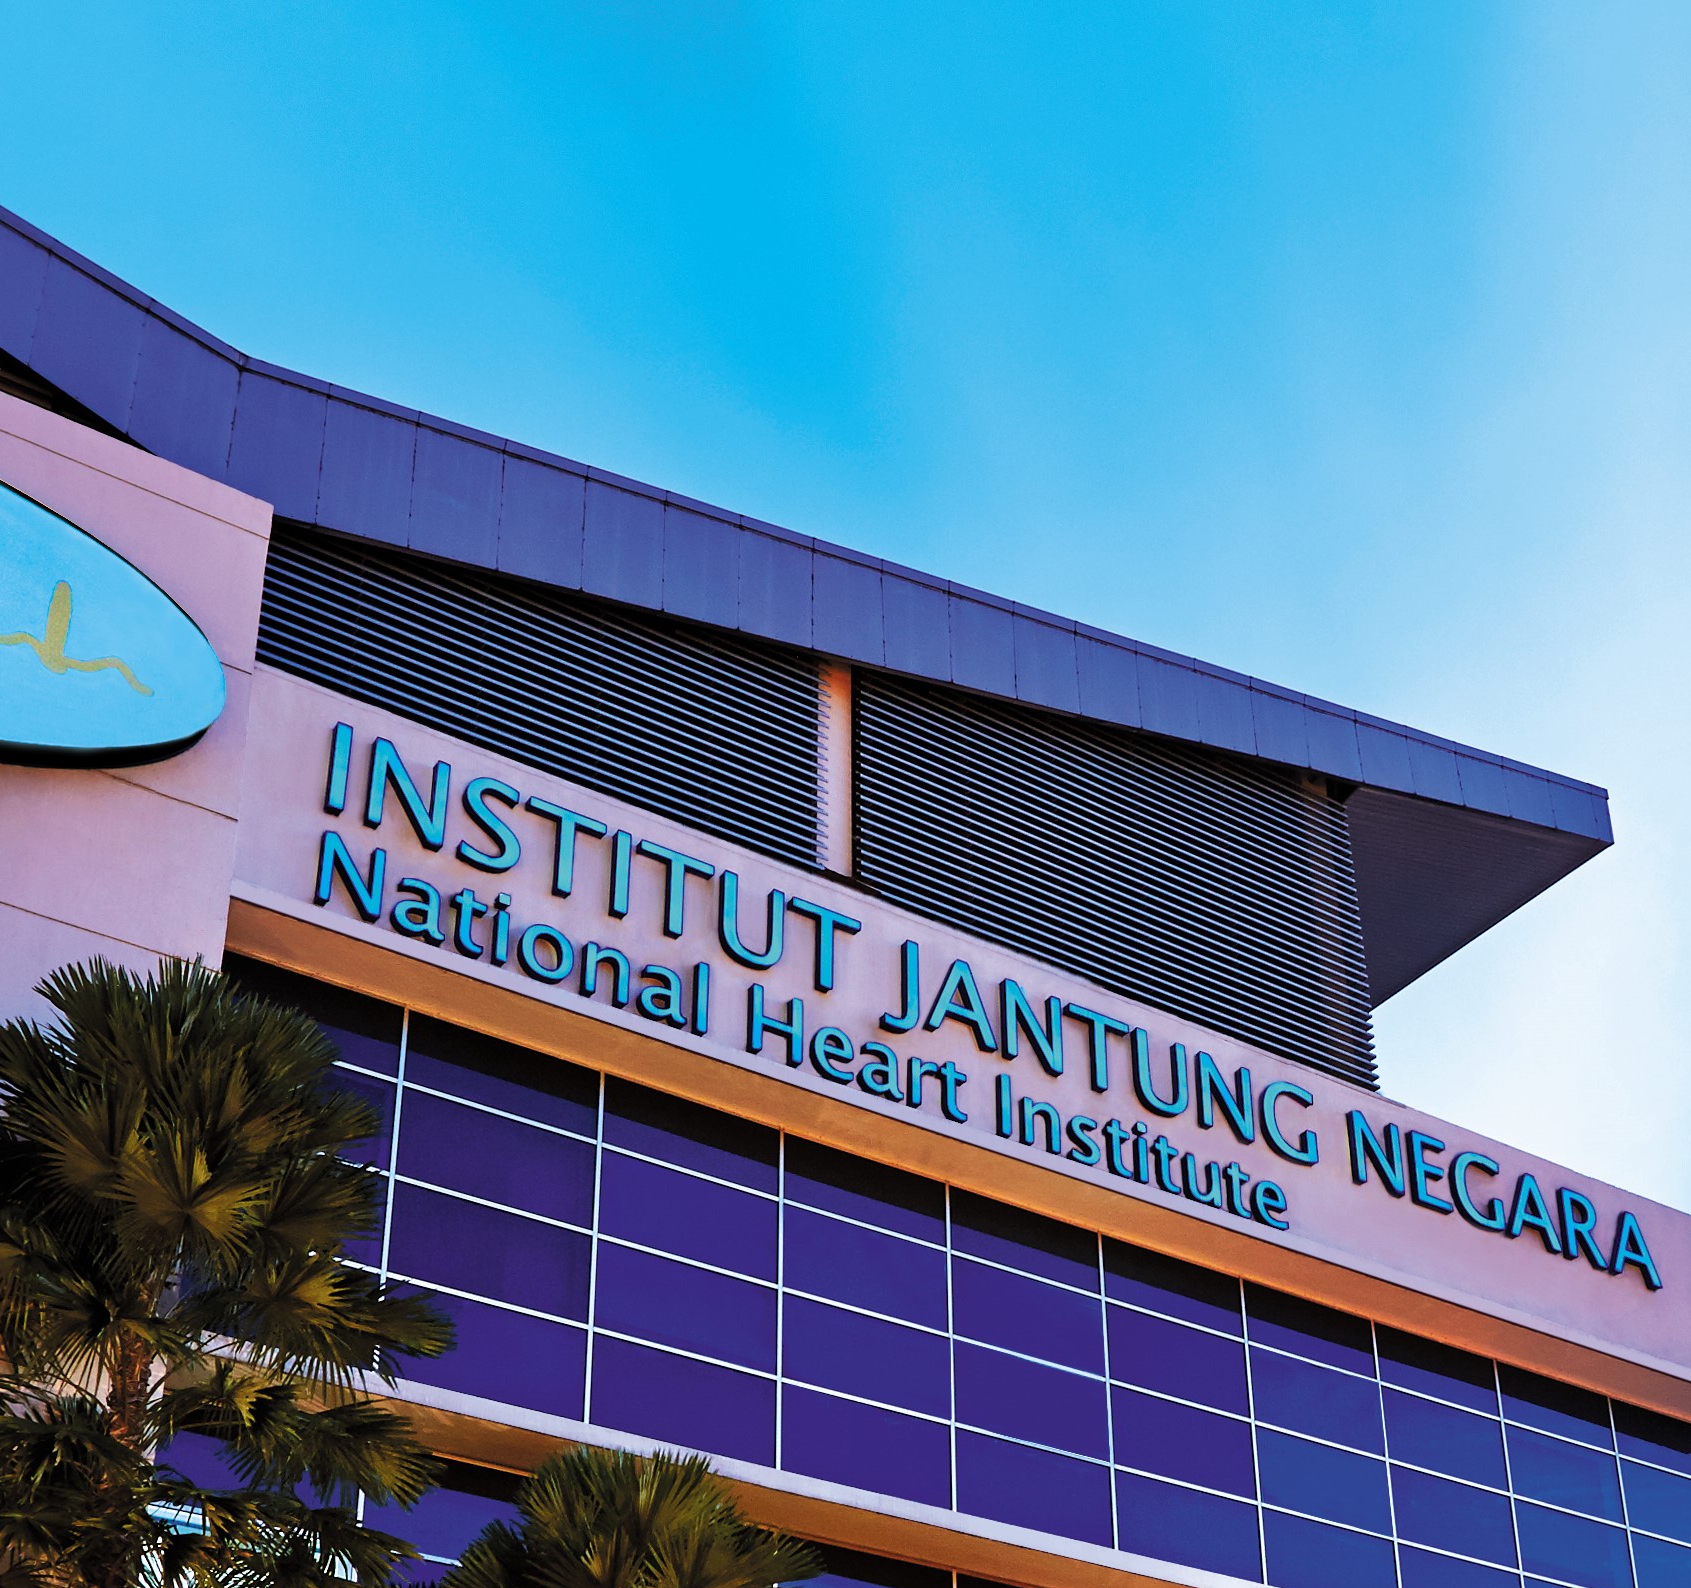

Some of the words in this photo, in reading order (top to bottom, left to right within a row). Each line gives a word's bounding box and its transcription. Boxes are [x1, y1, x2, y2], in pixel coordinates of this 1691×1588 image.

[314, 830, 711, 1037] National
[746, 982, 968, 1123] Heart
[995, 1073, 1290, 1231] Institute
[325, 722, 862, 992] INSTITUT
[879, 939, 1320, 1166] JANTUNG
[1347, 1109, 1663, 1292] NEGARA
